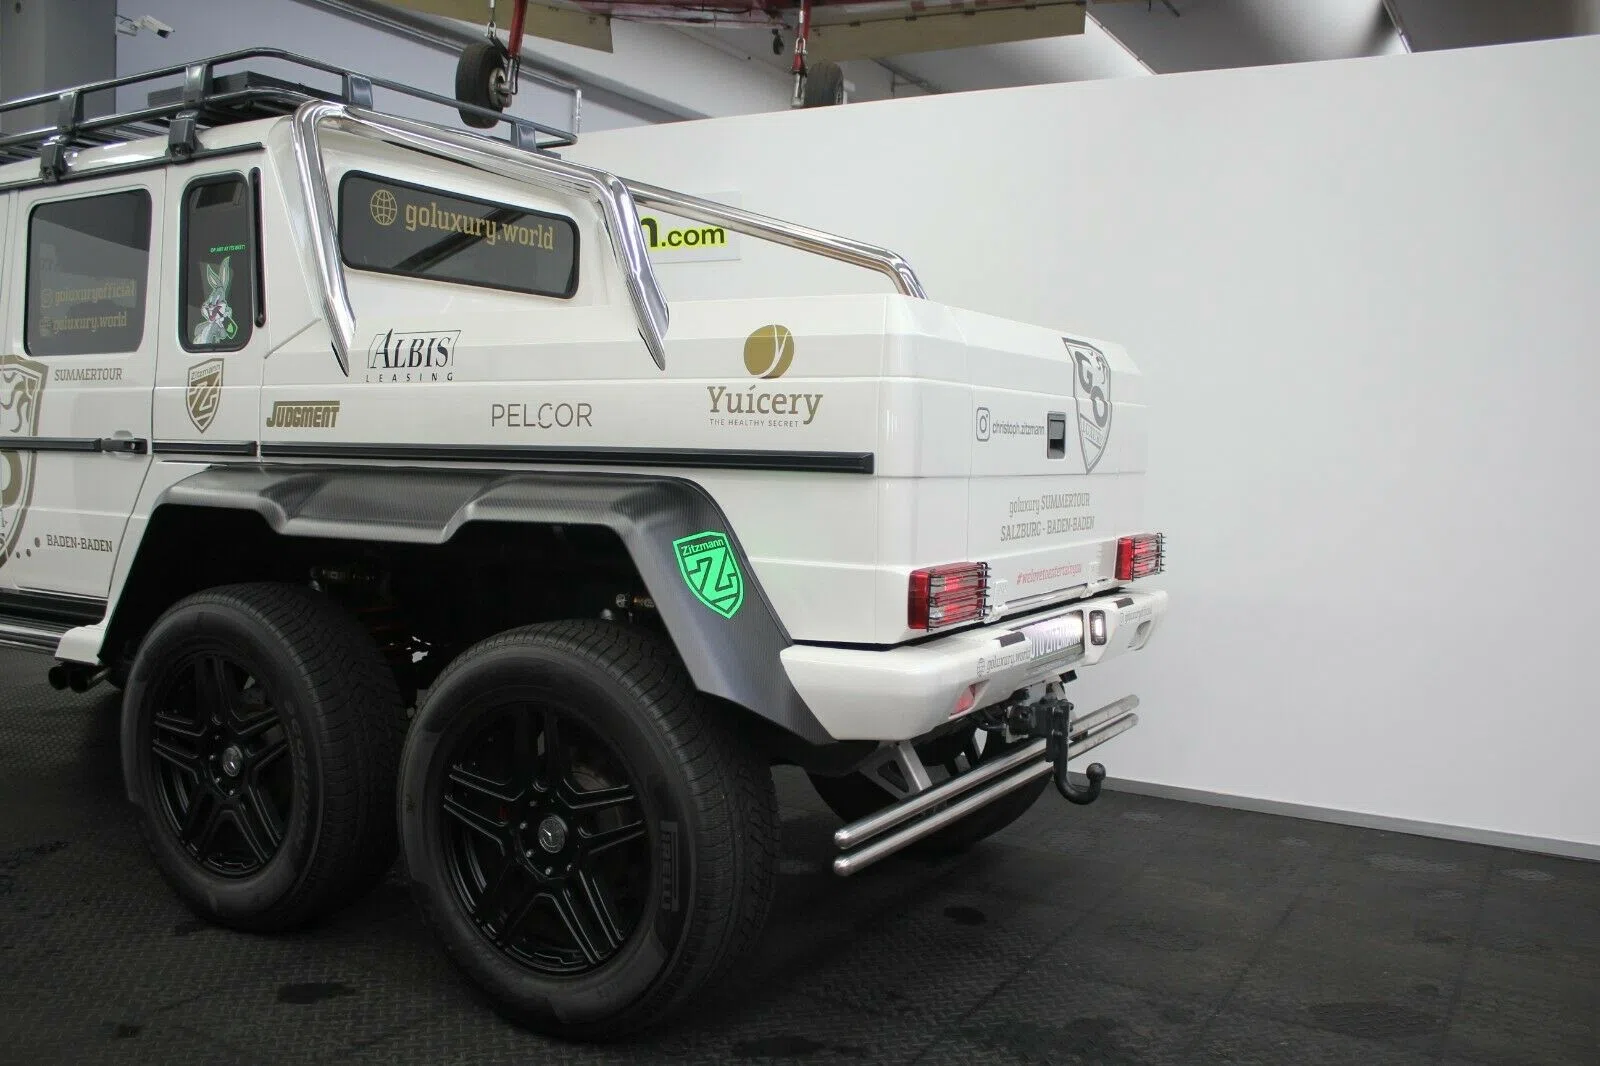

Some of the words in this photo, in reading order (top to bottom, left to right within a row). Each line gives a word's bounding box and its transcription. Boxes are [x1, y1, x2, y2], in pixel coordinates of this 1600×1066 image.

[405, 202, 554, 250] goluxury.world
[54, 367, 122, 381] SUMMERTOUR
[366, 373, 453, 382] LEASING
[266, 400, 340, 427] JUDGMENT
[491, 403, 592, 429] PELCOR
[710, 418, 725, 426] THE
[728, 419, 765, 427] HEALTHY
[768, 420, 799, 428] SECRET
[1009, 496, 1040, 517] goluxury
[1041, 492, 1090, 510] SUMMERTOUR
[1000, 521, 1041, 542] SALZBURG
[1047, 516, 1095, 535] BADEN-BADEN
[46, 534, 113, 552] BADEN-BADEN
[681, 539, 724, 556] Zitzmann
